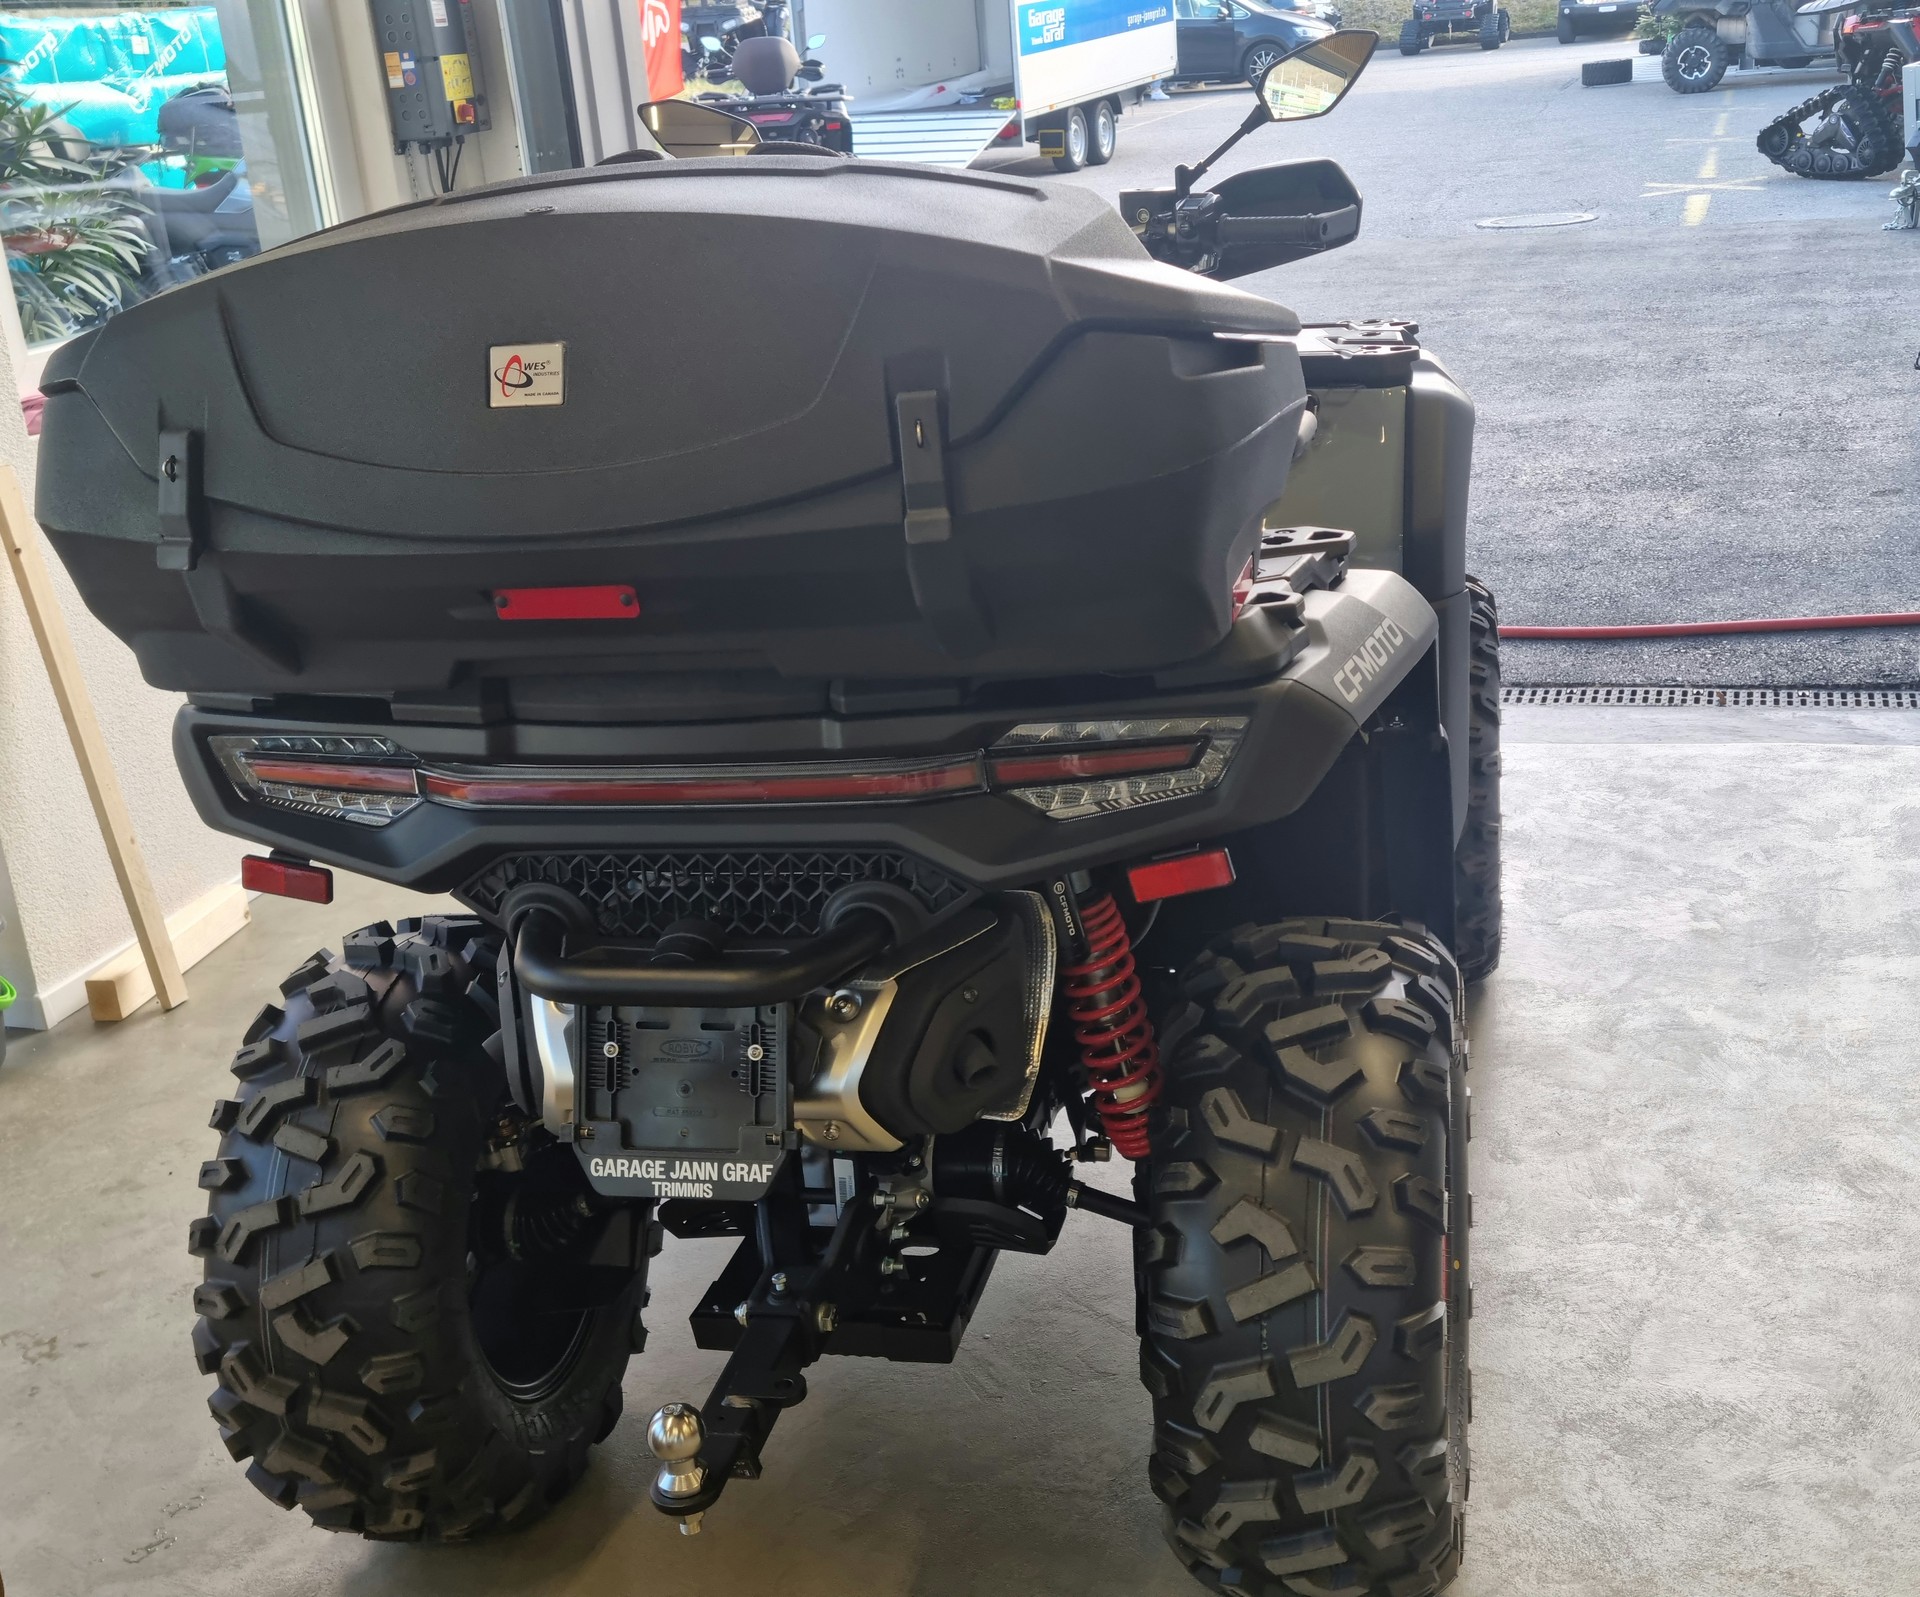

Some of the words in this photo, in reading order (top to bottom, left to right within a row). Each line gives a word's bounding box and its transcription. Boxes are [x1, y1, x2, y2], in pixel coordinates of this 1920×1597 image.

[1028, 8, 1065, 27] Garage
[1043, 22, 1065, 44] Graf
[1333, 617, 1404, 703] CFMOTO
[1059, 895, 1076, 936] CFMOTO
[590, 1158, 666, 1179] GARAGE
[670, 1160, 718, 1181] JANN
[722, 1162, 774, 1183] GRAF
[651, 1181, 713, 1198] TRIMMIS
